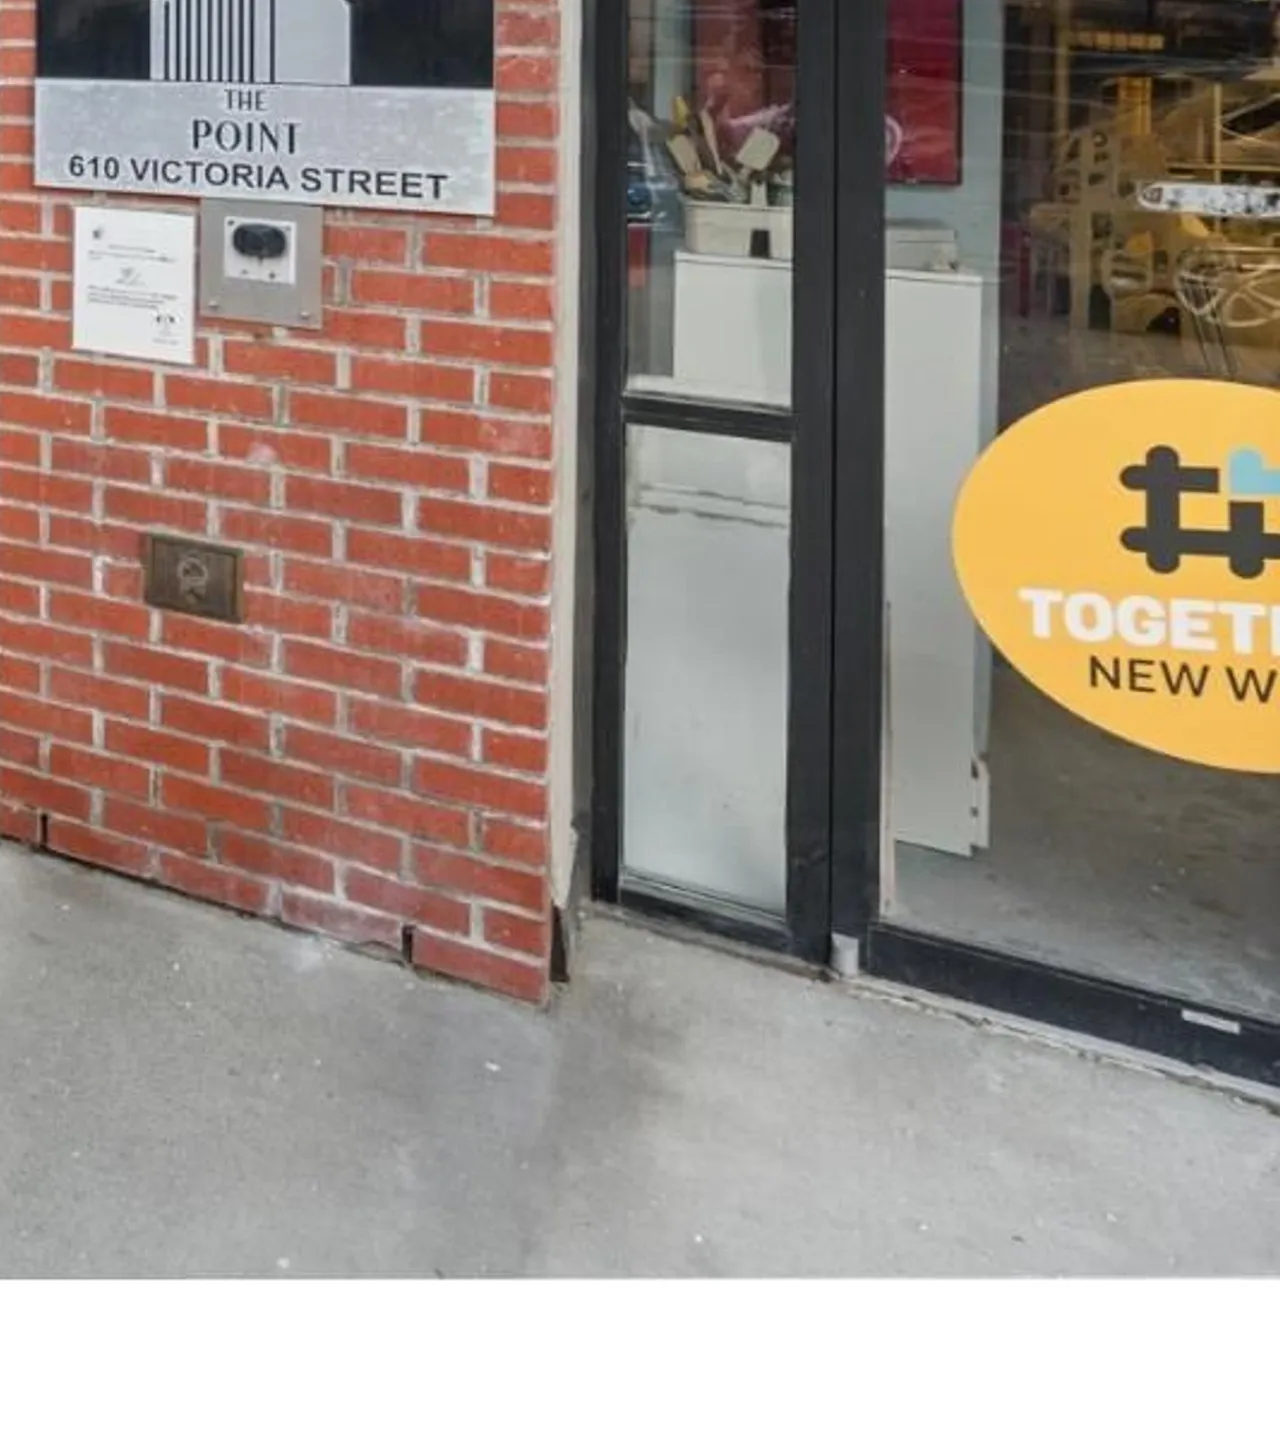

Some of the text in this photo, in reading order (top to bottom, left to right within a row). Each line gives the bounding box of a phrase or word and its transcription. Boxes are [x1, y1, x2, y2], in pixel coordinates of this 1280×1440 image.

[224, 88, 268, 111] THE
[192, 119, 302, 155] POINT
[69, 155, 450, 200] 610 VICTORIA STREET
[1018, 587, 1280, 657] TOGET
[1089, 654, 1211, 698] NEW
